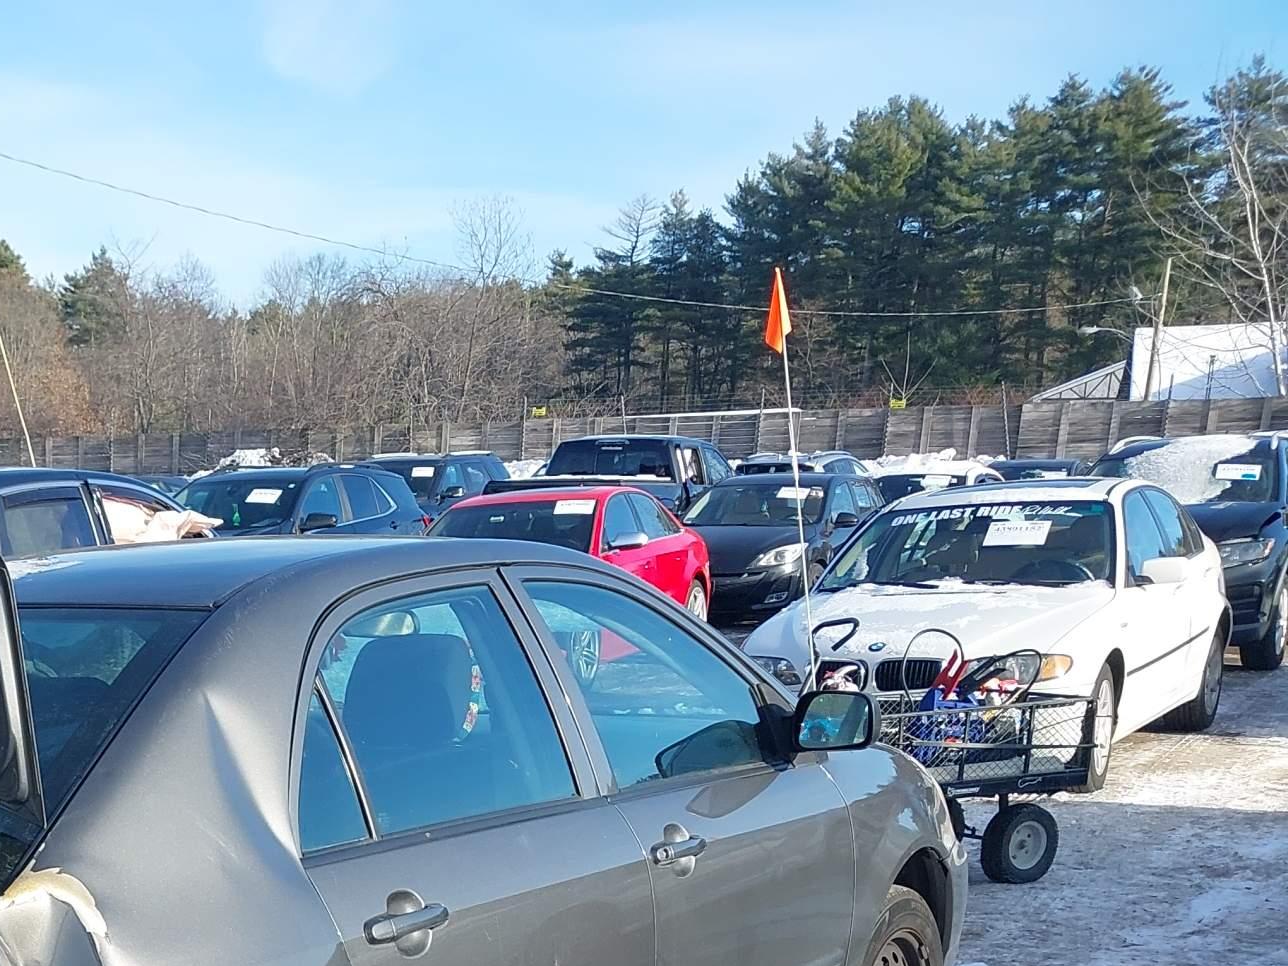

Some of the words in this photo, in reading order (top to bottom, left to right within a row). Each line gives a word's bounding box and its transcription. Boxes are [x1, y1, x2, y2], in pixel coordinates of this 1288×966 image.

[891, 512, 927, 527] ONE
[928, 508, 975, 521] LAST
[976, 505, 1023, 517] RIDE
